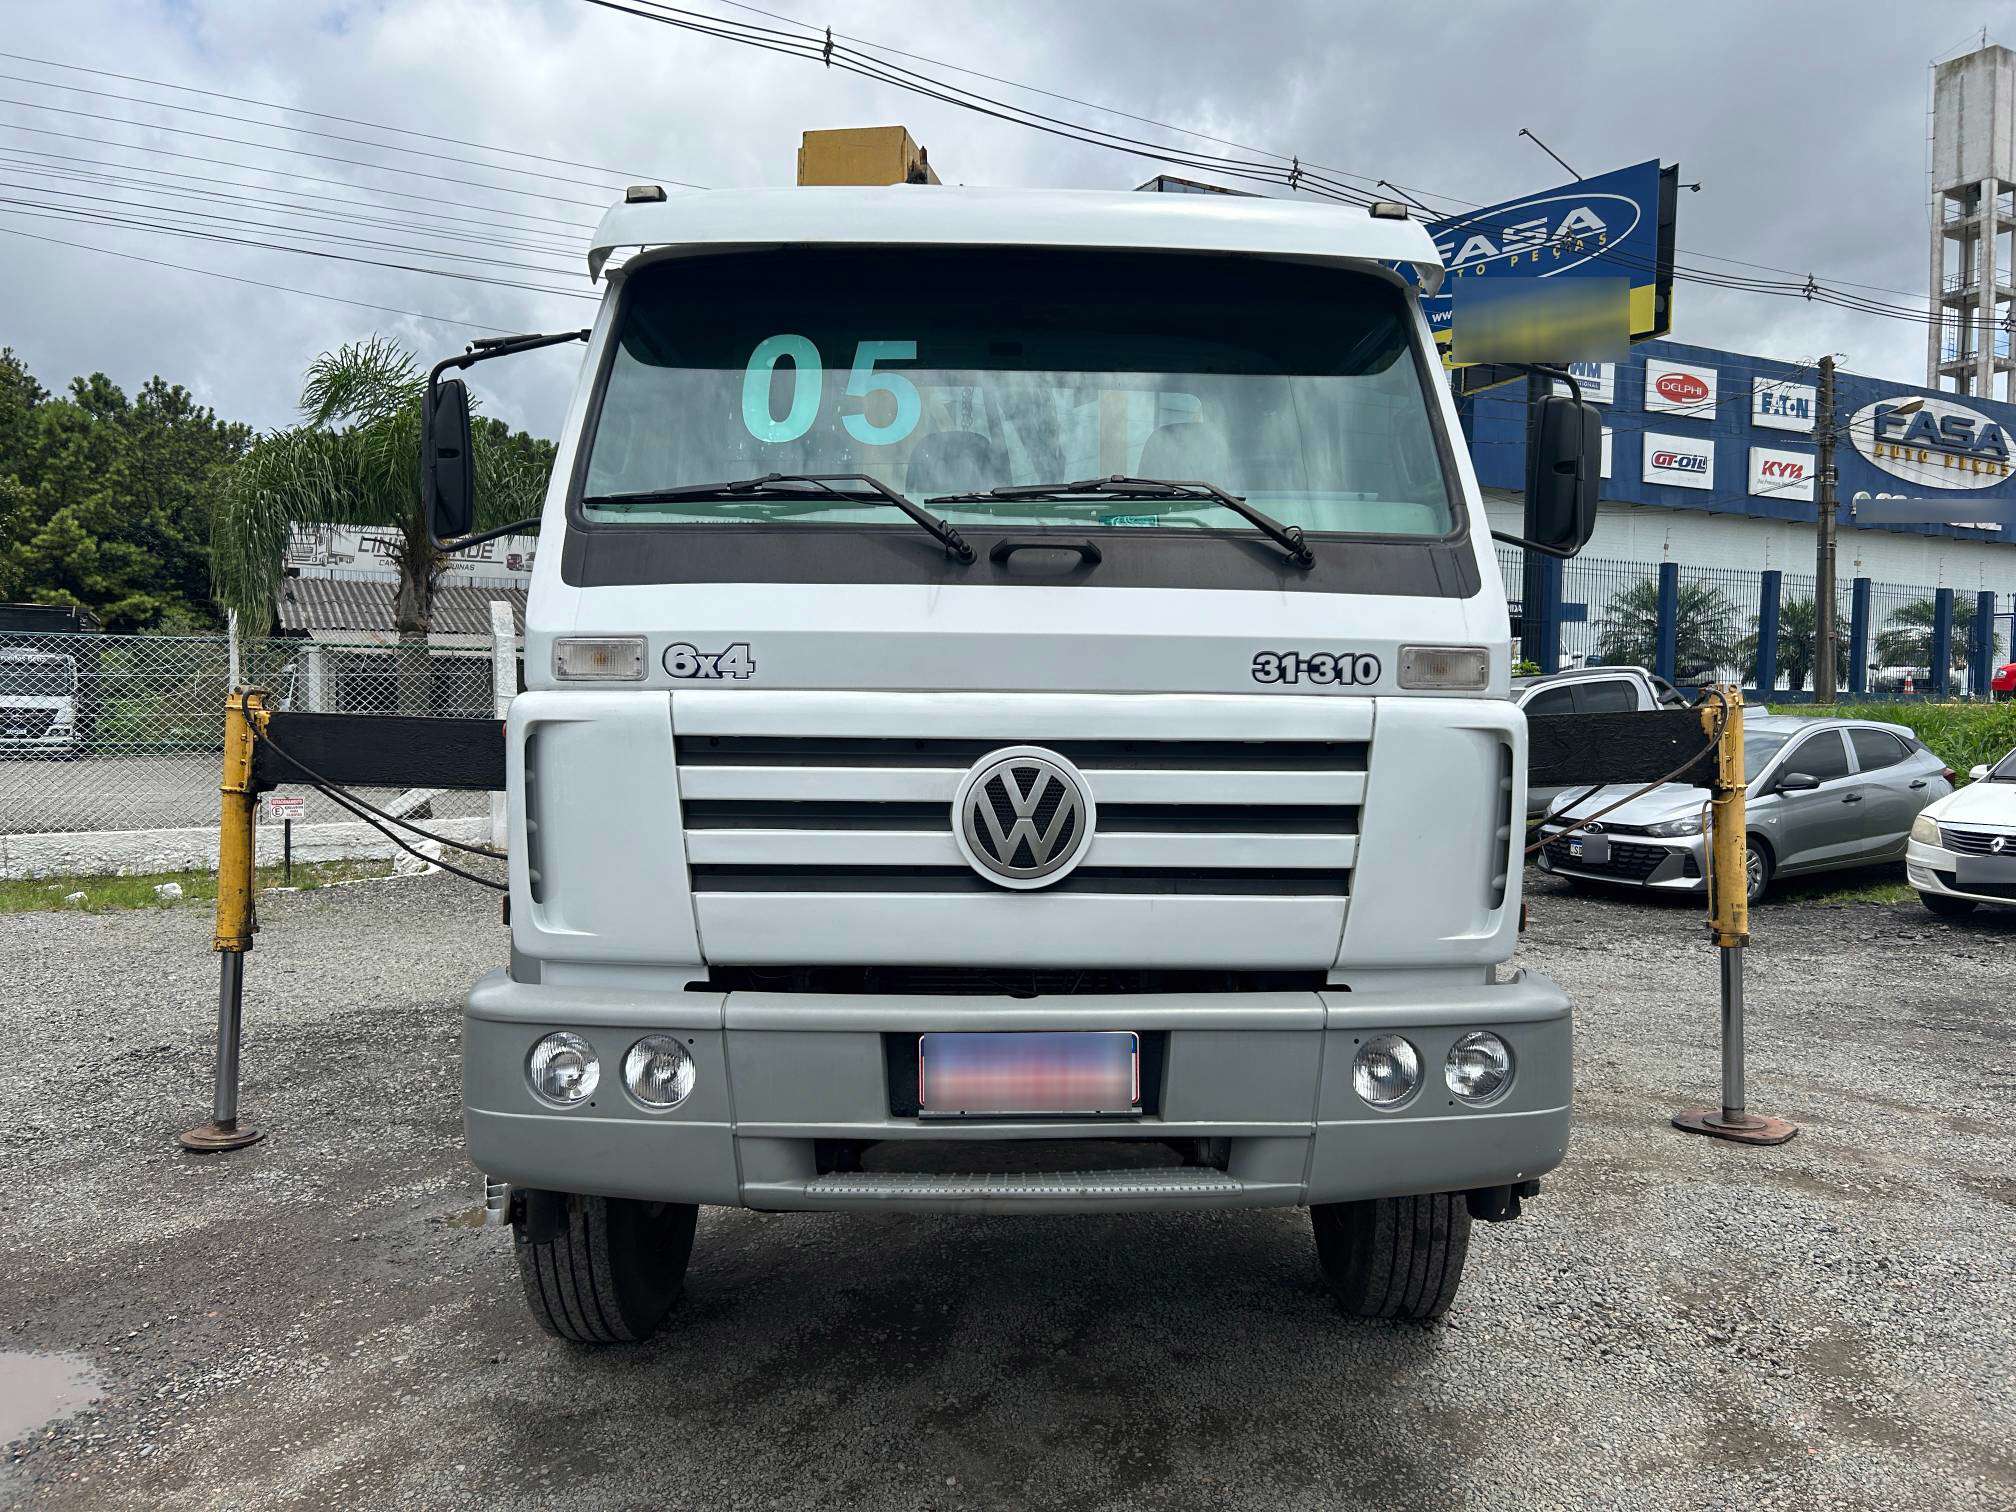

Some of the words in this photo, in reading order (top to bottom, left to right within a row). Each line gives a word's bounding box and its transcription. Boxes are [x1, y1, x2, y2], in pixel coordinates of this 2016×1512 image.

[1510, 233, 1607, 269] PEÇAS
[1661, 381, 1702, 396] DELPHI
[1762, 392, 1808, 418] EATON
[1874, 403, 2009, 456] FASA
[1874, 443, 1928, 463] AUTO
[1762, 460, 1803, 478] KYB
[662, 642, 756, 679] 6x4
[1252, 651, 1381, 685] 31-310
